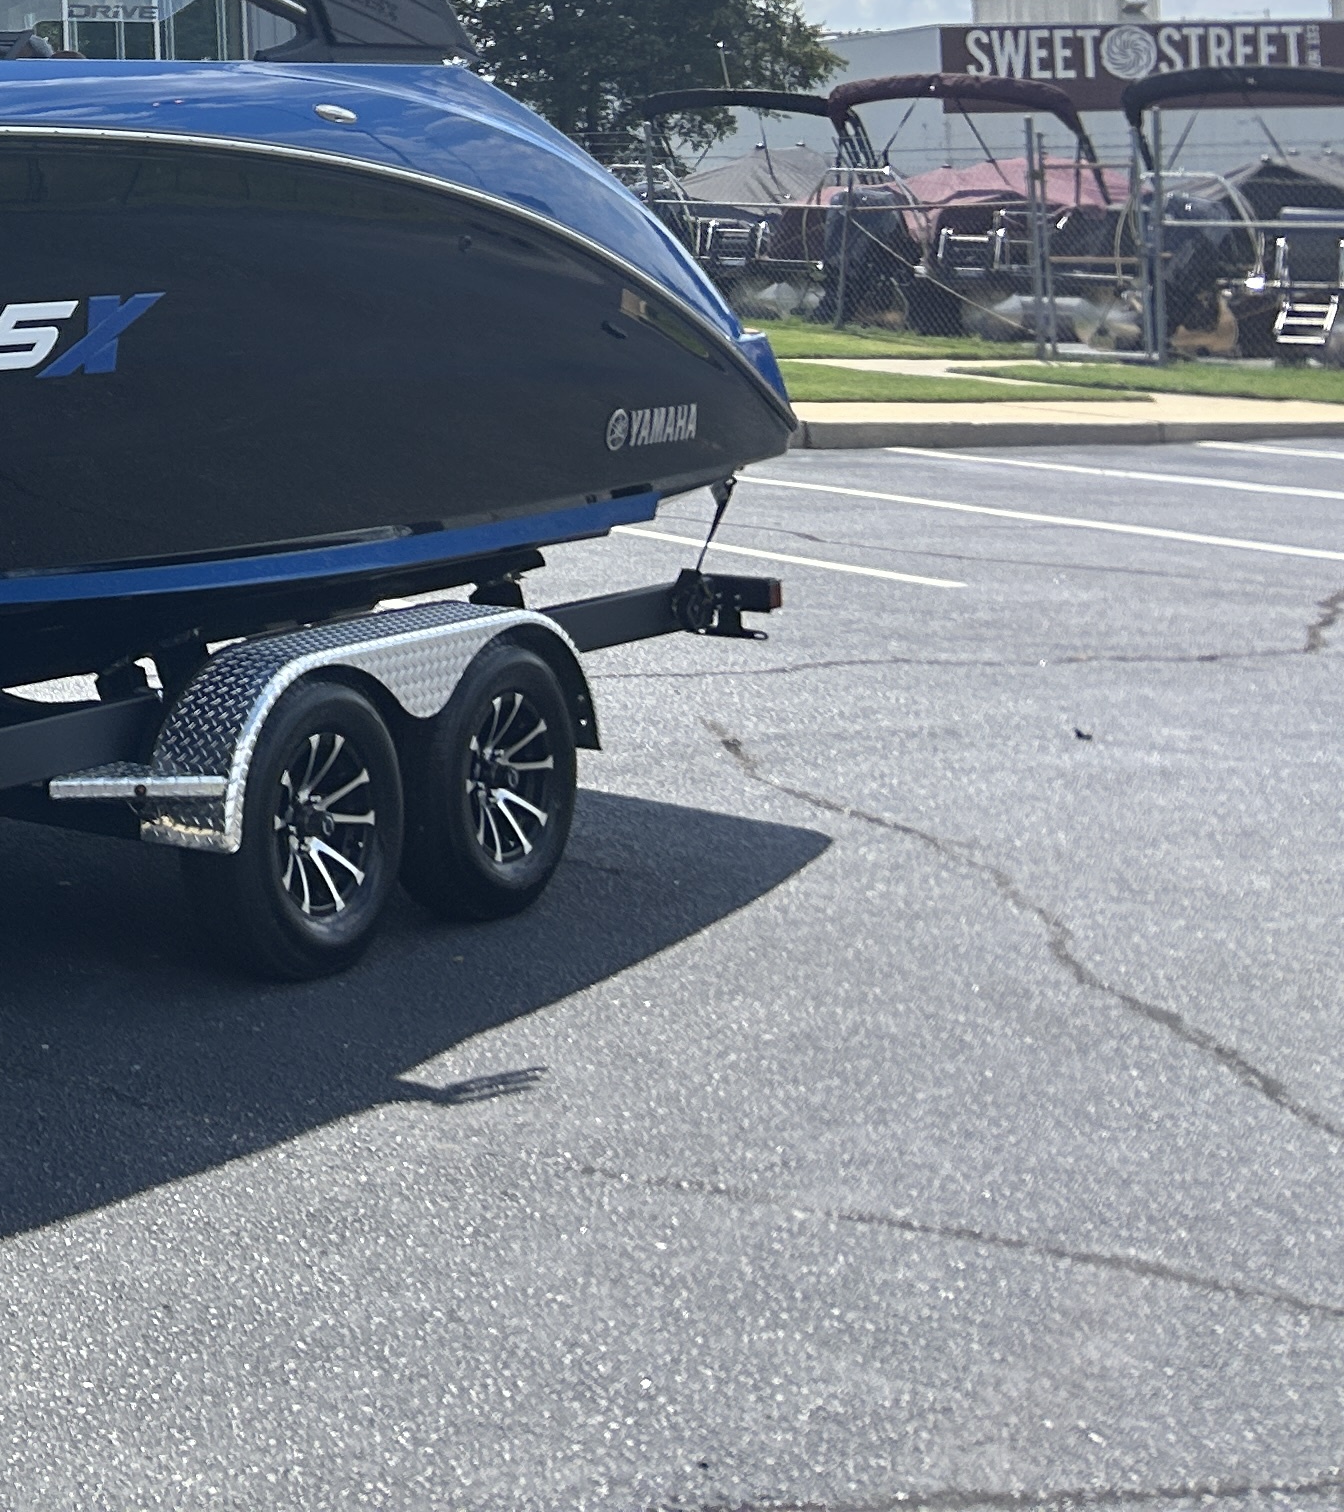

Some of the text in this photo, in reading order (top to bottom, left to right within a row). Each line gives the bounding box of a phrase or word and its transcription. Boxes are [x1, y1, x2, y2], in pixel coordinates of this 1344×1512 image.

[966, 29, 1102, 80] SWEET
[1159, 25, 1303, 72] STREET
[629, 403, 697, 446] YAMAHA
